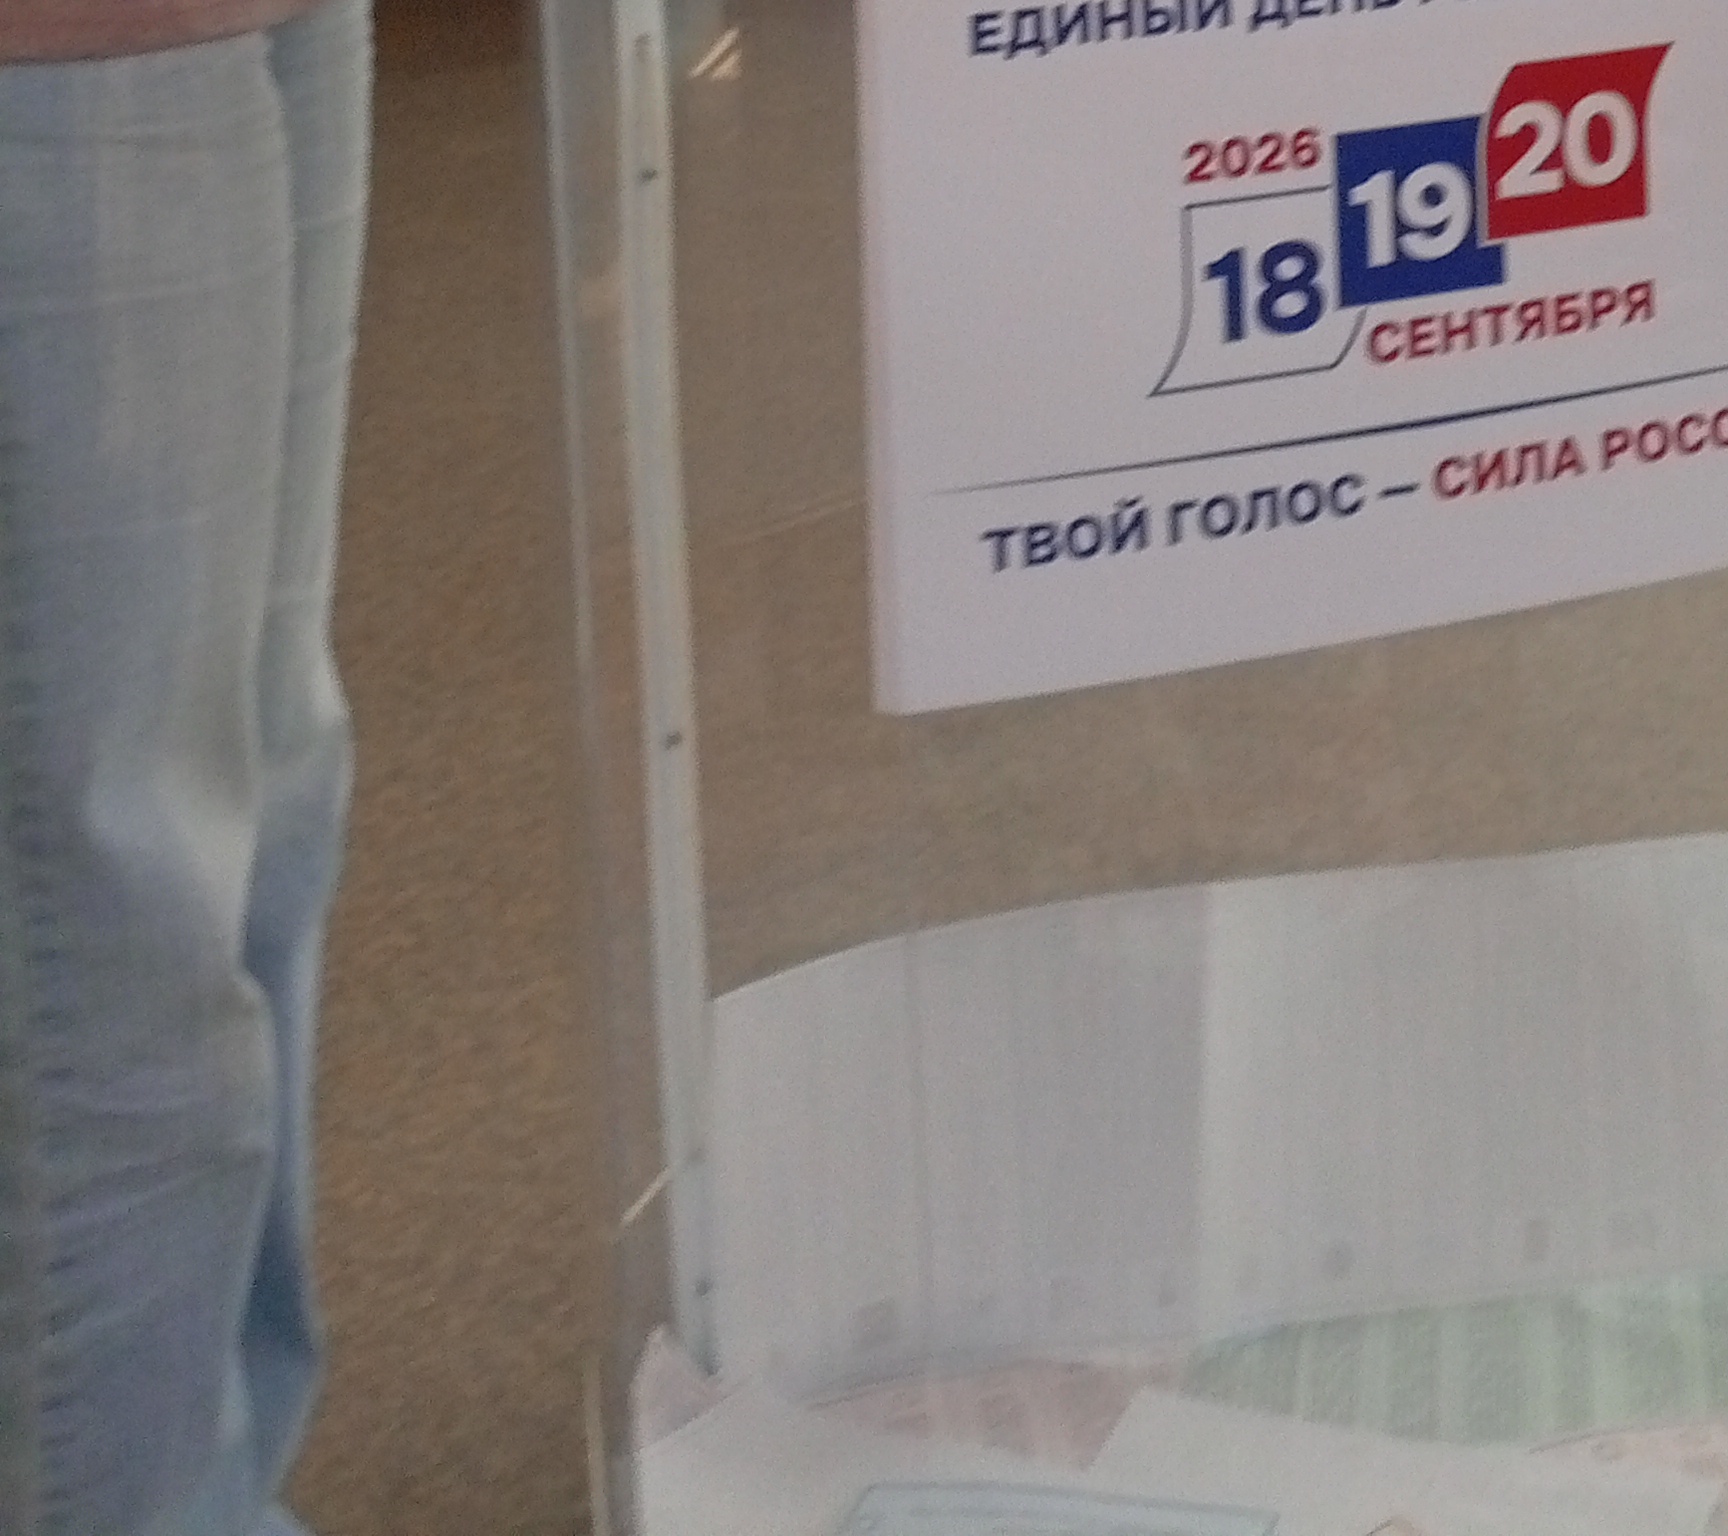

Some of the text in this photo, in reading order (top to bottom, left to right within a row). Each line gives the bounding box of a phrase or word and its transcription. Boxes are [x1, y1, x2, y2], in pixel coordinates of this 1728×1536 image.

[1182, 128, 1323, 184] 2026
[1204, 91, 1638, 343] 18 19 20
[1366, 280, 1656, 365] СЕНТЯБРЯ
[981, 498, 1151, 573] ТВОЙ
[1165, 472, 1367, 546] ГОЛОС
[1431, 436, 1587, 503] СИЛА
